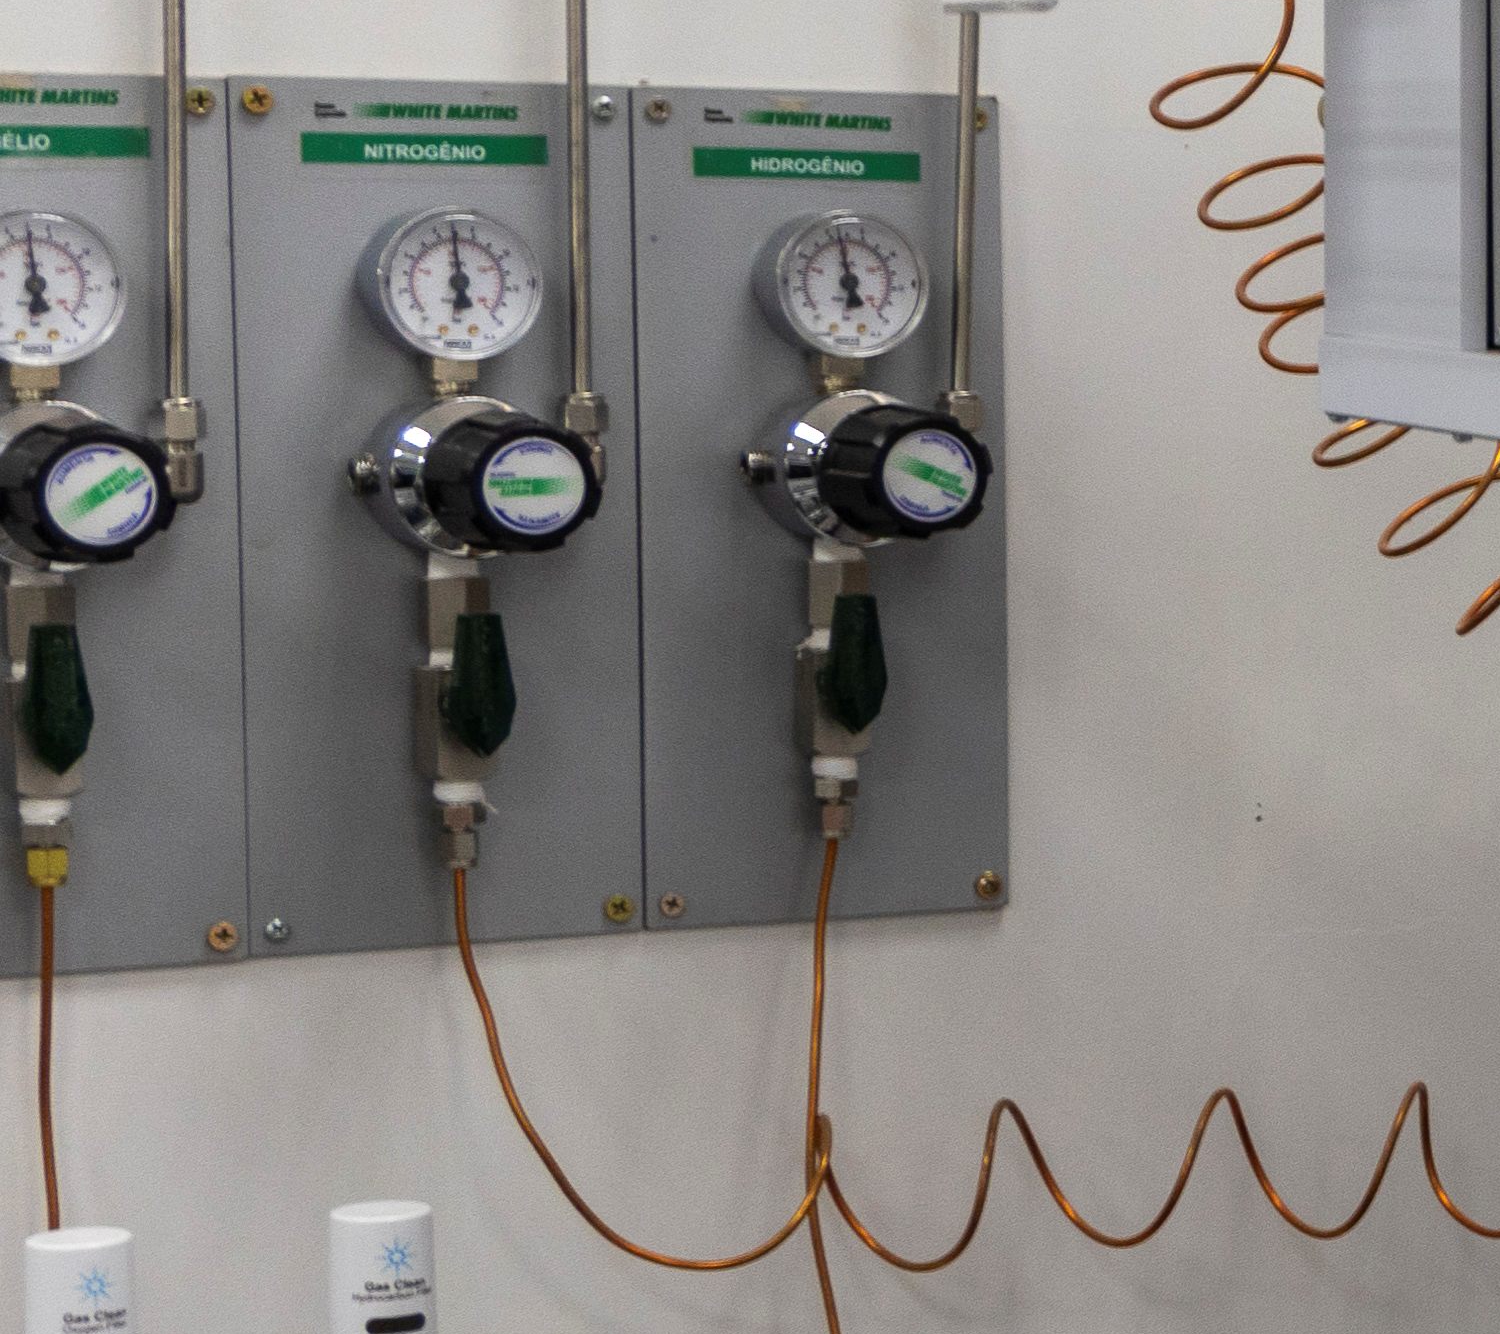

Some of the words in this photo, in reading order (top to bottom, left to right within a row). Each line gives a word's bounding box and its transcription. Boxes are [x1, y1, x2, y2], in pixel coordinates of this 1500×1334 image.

[0, 88, 37, 104] HITE
[40, 88, 120, 105] MARTINS
[390, 103, 443, 120] WHITE
[445, 104, 519, 121] MARTINS
[775, 112, 823, 128] WHITE
[824, 113, 893, 132] MARTINS
[0, 130, 51, 151] ÉLIO
[363, 141, 486, 161] NITROGÊNIO
[750, 155, 865, 176] HIDROGÊNIO
[364, 1279, 391, 1292] Gas
[393, 1277, 426, 1290] Clean
[62, 1311, 91, 1324] Gas
